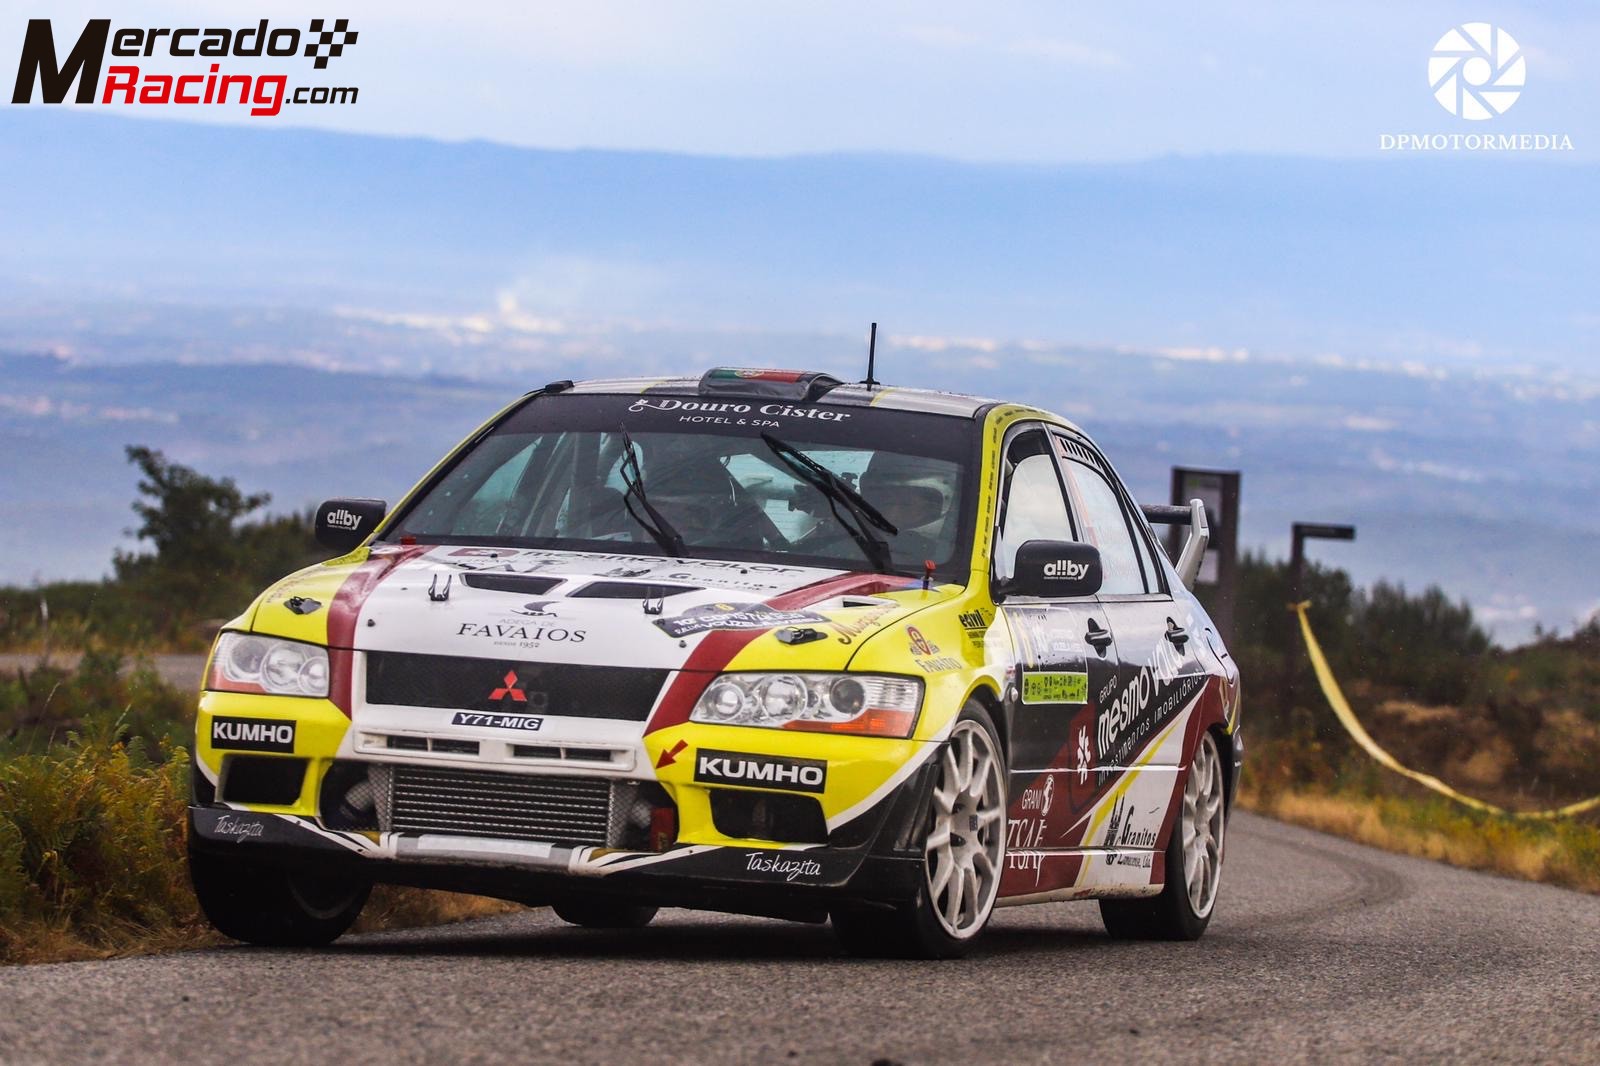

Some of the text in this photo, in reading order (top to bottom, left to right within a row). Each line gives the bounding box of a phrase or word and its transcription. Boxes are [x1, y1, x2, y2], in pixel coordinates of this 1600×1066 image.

[647, 398, 851, 422] Douro Cister
[679, 415, 732, 425] HOTEL
[751, 419, 780, 428] SPA
[456, 623, 587, 643] FAVAIOS
[518, 641, 541, 649] 1952
[1100, 674, 1117, 704] GRUPO
[212, 721, 294, 744] KUMHO
[459, 713, 540, 730] Y71-MIG
[699, 756, 824, 785] KUMHO
[1120, 804, 1157, 846] Granitos
[745, 851, 822, 882] Taskazita
